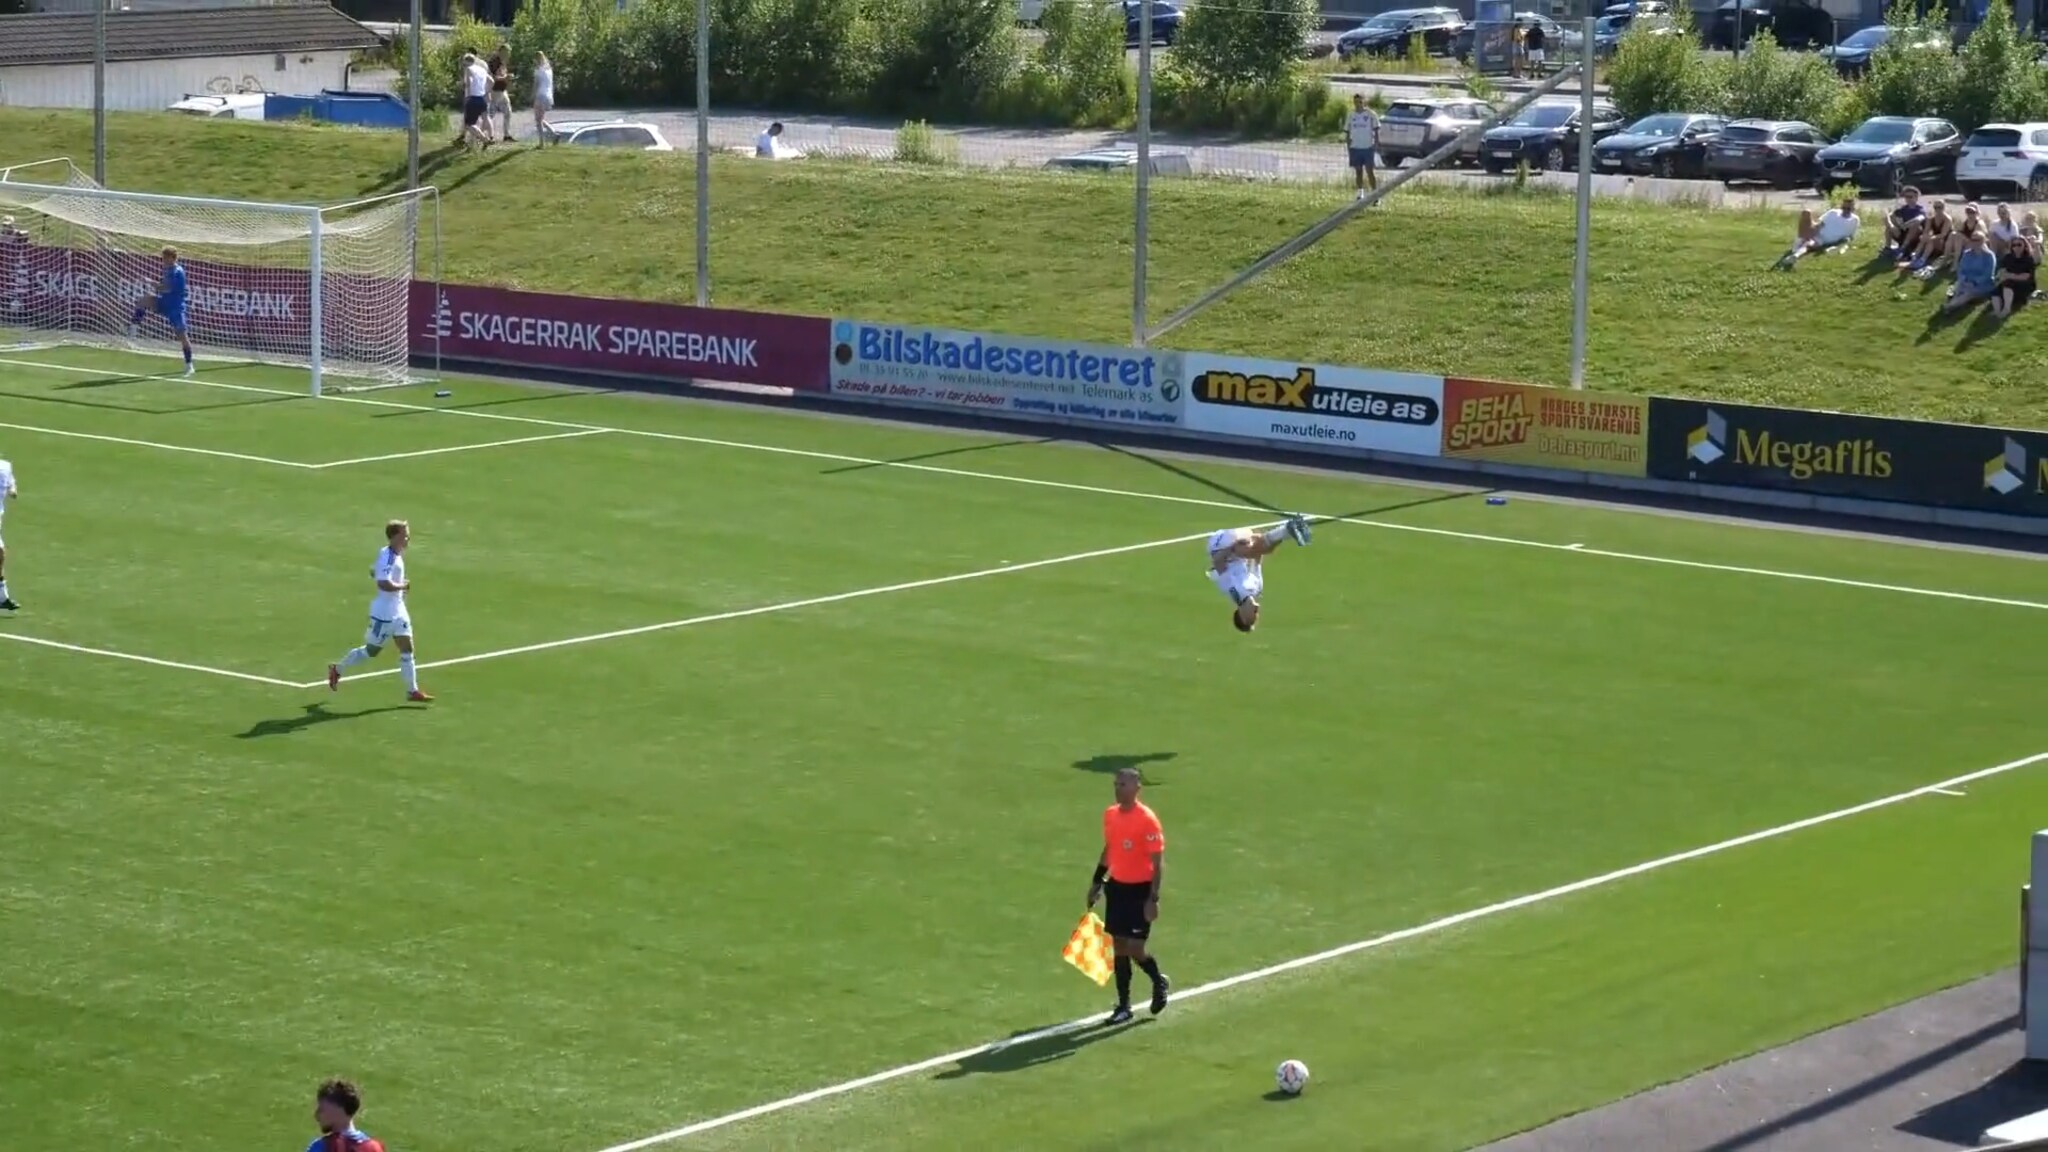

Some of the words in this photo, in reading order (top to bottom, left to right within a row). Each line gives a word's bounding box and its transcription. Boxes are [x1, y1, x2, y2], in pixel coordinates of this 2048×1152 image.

[460, 311, 602, 351] SKAGERRAK
[609, 326, 757, 367] SPAREBANK
[859, 326, 1156, 388] Bilskadesenteret
[836, 379, 870, 393] Skade
[872, 383, 887, 394] på
[890, 384, 926, 397] billen?
[935, 388, 946, 399] vi
[962, 391, 1006, 405] jobben
[1082, 383, 1136, 401] Telemark
[1140, 391, 1153, 403] as
[1206, 368, 1315, 408] max
[1312, 390, 1388, 416] utleie
[1391, 401, 1427, 420] as
[1460, 393, 1525, 424] BEHA
[1540, 398, 1585, 415] NORGES
[1589, 402, 1640, 420] STØRSTE
[1270, 421, 1356, 442] maxutleie.no
[1448, 415, 1533, 447] SPORT
[1540, 413, 1640, 435] SPORTSVAREHUS
[1539, 434, 1641, 463] behasport.no
[1734, 427, 1893, 480] Megaflis
